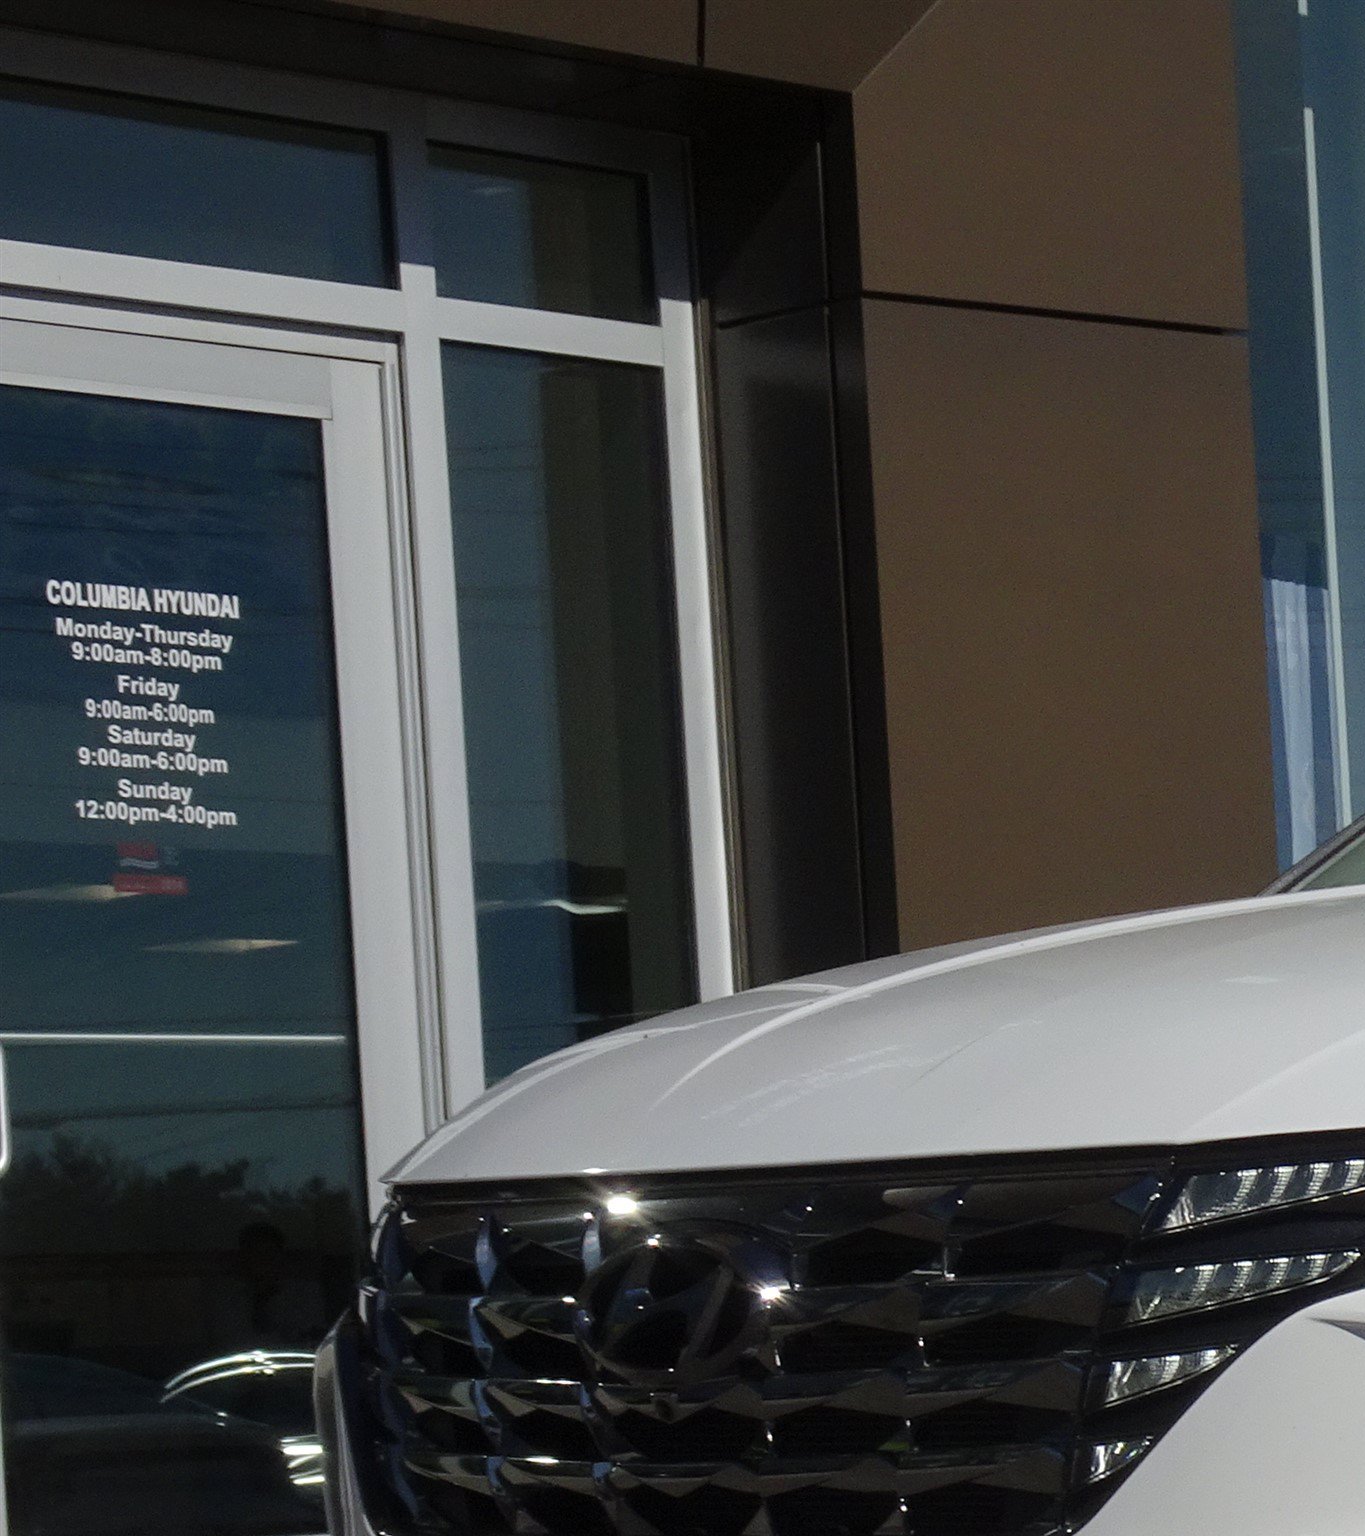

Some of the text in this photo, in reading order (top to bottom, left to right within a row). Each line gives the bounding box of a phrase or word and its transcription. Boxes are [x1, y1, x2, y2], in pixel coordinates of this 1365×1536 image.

[46, 579, 240, 619] COLUMBIA HYUNDAI
[55, 617, 233, 653] Monday-Thursday
[71, 641, 223, 673] 9:00am-8:00pm
[117, 675, 180, 701] Friday
[84, 698, 215, 727] 9:00am-6:00pm
[107, 725, 196, 751] Saturday
[77, 747, 228, 775] 9:00am-6:00pm
[117, 779, 193, 804] Sunday
[75, 800, 238, 829] 12:00pm-4:00pm
